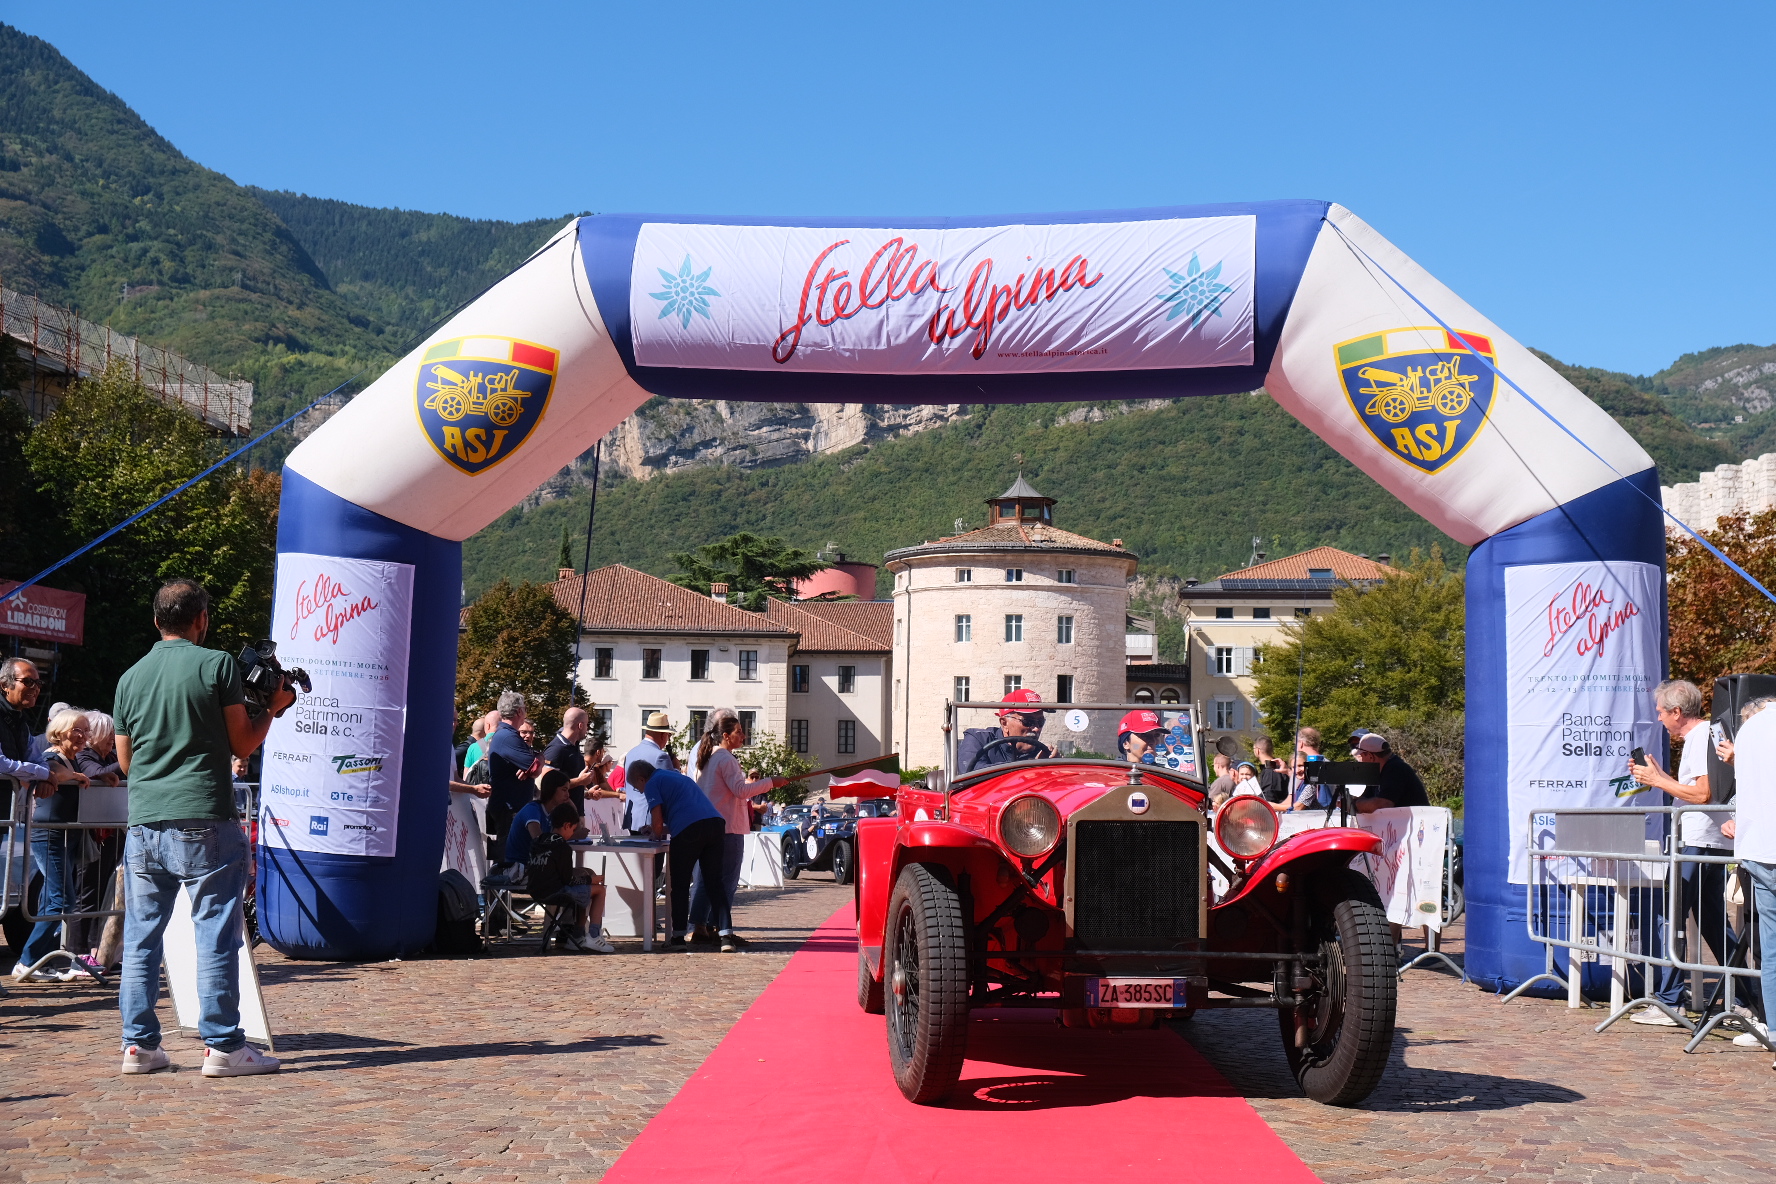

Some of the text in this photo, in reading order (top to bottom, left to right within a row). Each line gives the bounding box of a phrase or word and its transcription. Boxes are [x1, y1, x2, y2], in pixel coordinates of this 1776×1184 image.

[772, 236, 1104, 364] Stella alpina
[997, 347, 1108, 358] www.stellaalpinastorica.it
[442, 426, 508, 463] ASI
[1391, 420, 1461, 461] ASI
[28, 603, 67, 618] COSTRUZIONI
[291, 573, 352, 640] Stella
[7, 610, 66, 631] LIBARDONI
[314, 596, 378, 645] alpina
[1544, 582, 1614, 657] Stella
[1577, 601, 1640, 658] alpina
[314, 668, 365, 679] SETTEMBRE
[297, 693, 339, 708] Banca
[295, 706, 362, 724] Patrimoni
[1073, 715, 1081, 725] 5
[1562, 712, 1612, 727] Banca
[295, 720, 355, 738] Sella & C.
[1562, 727, 1634, 742] Patrimoni
[273, 752, 312, 763] FERRARI
[1562, 743, 1630, 757] Sella & C.
[331, 753, 383, 774] Tassoni
[271, 784, 310, 798] ASIshop.it
[1529, 780, 1587, 789] FERRARI
[310, 820, 328, 832] Rai
[1100, 984, 1119, 1003] ZA
[1124, 984, 1173, 1003] 385SC
